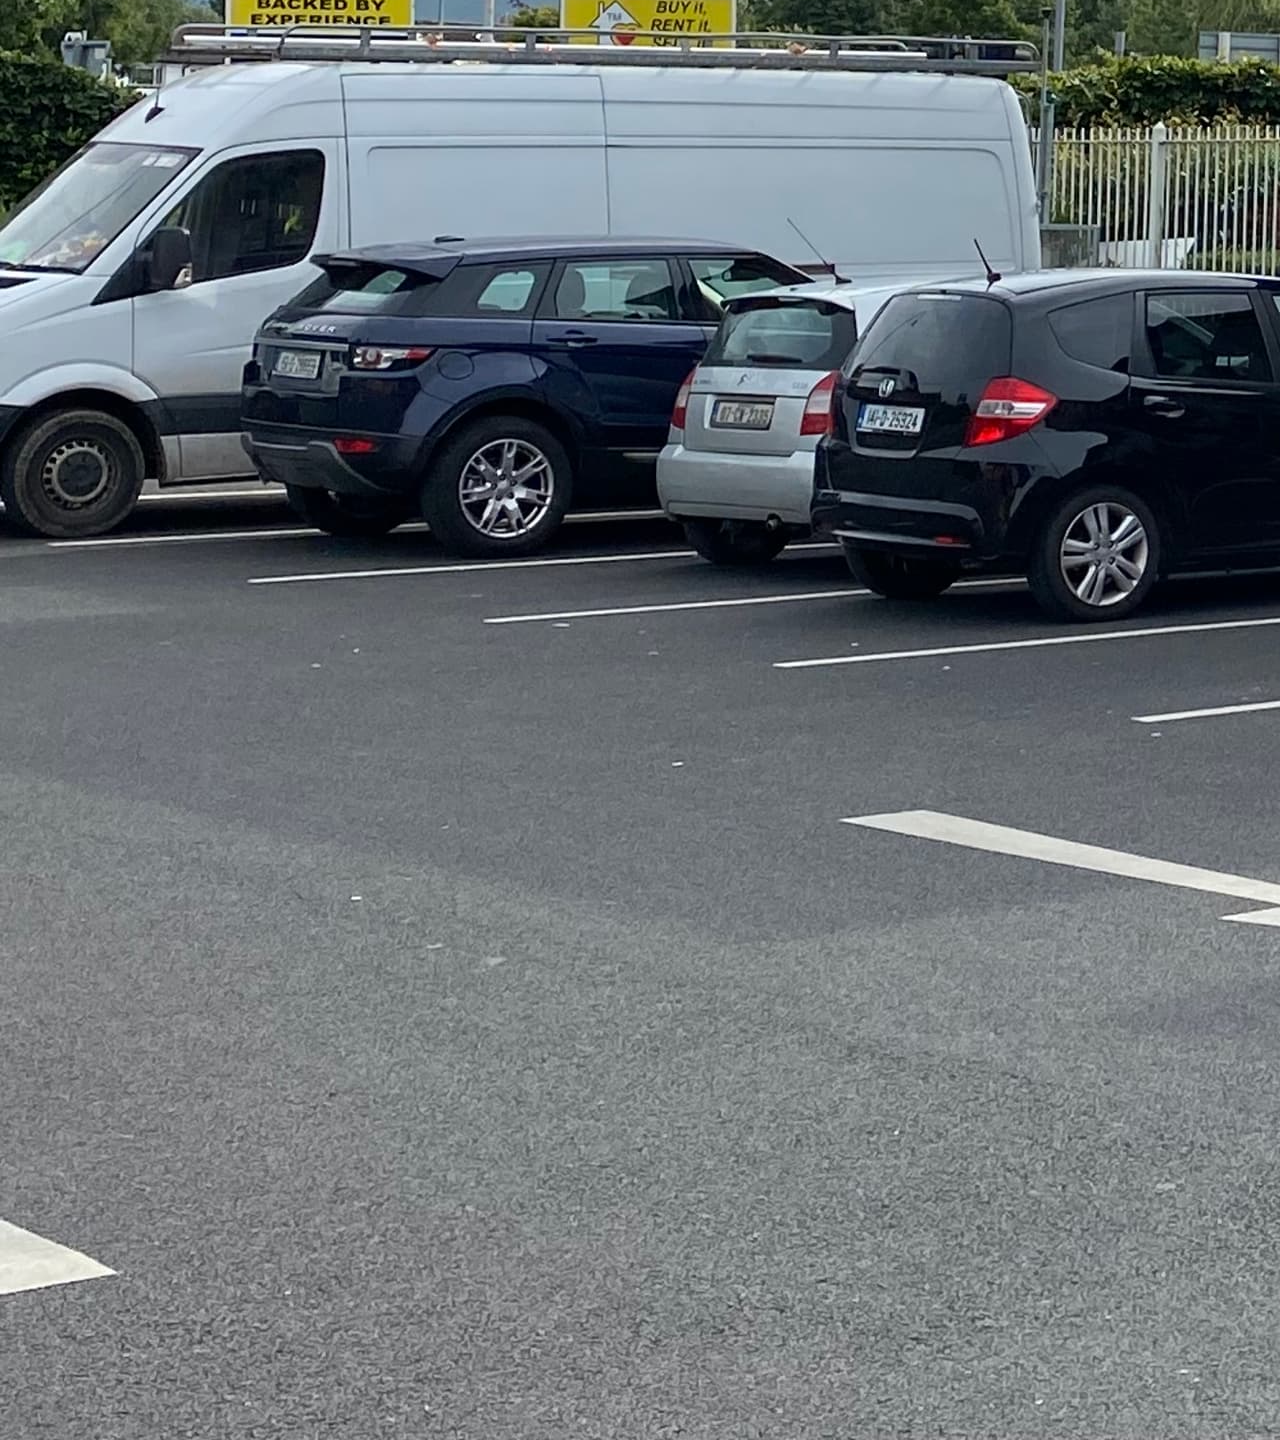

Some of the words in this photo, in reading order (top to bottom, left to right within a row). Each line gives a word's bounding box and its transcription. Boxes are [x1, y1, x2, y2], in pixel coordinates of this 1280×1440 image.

[356, 0, 385, 11] BY
[656, 1, 691, 14] BUY
[251, 14, 391, 25] EXPERIENCE
[651, 19, 696, 32] RENT
